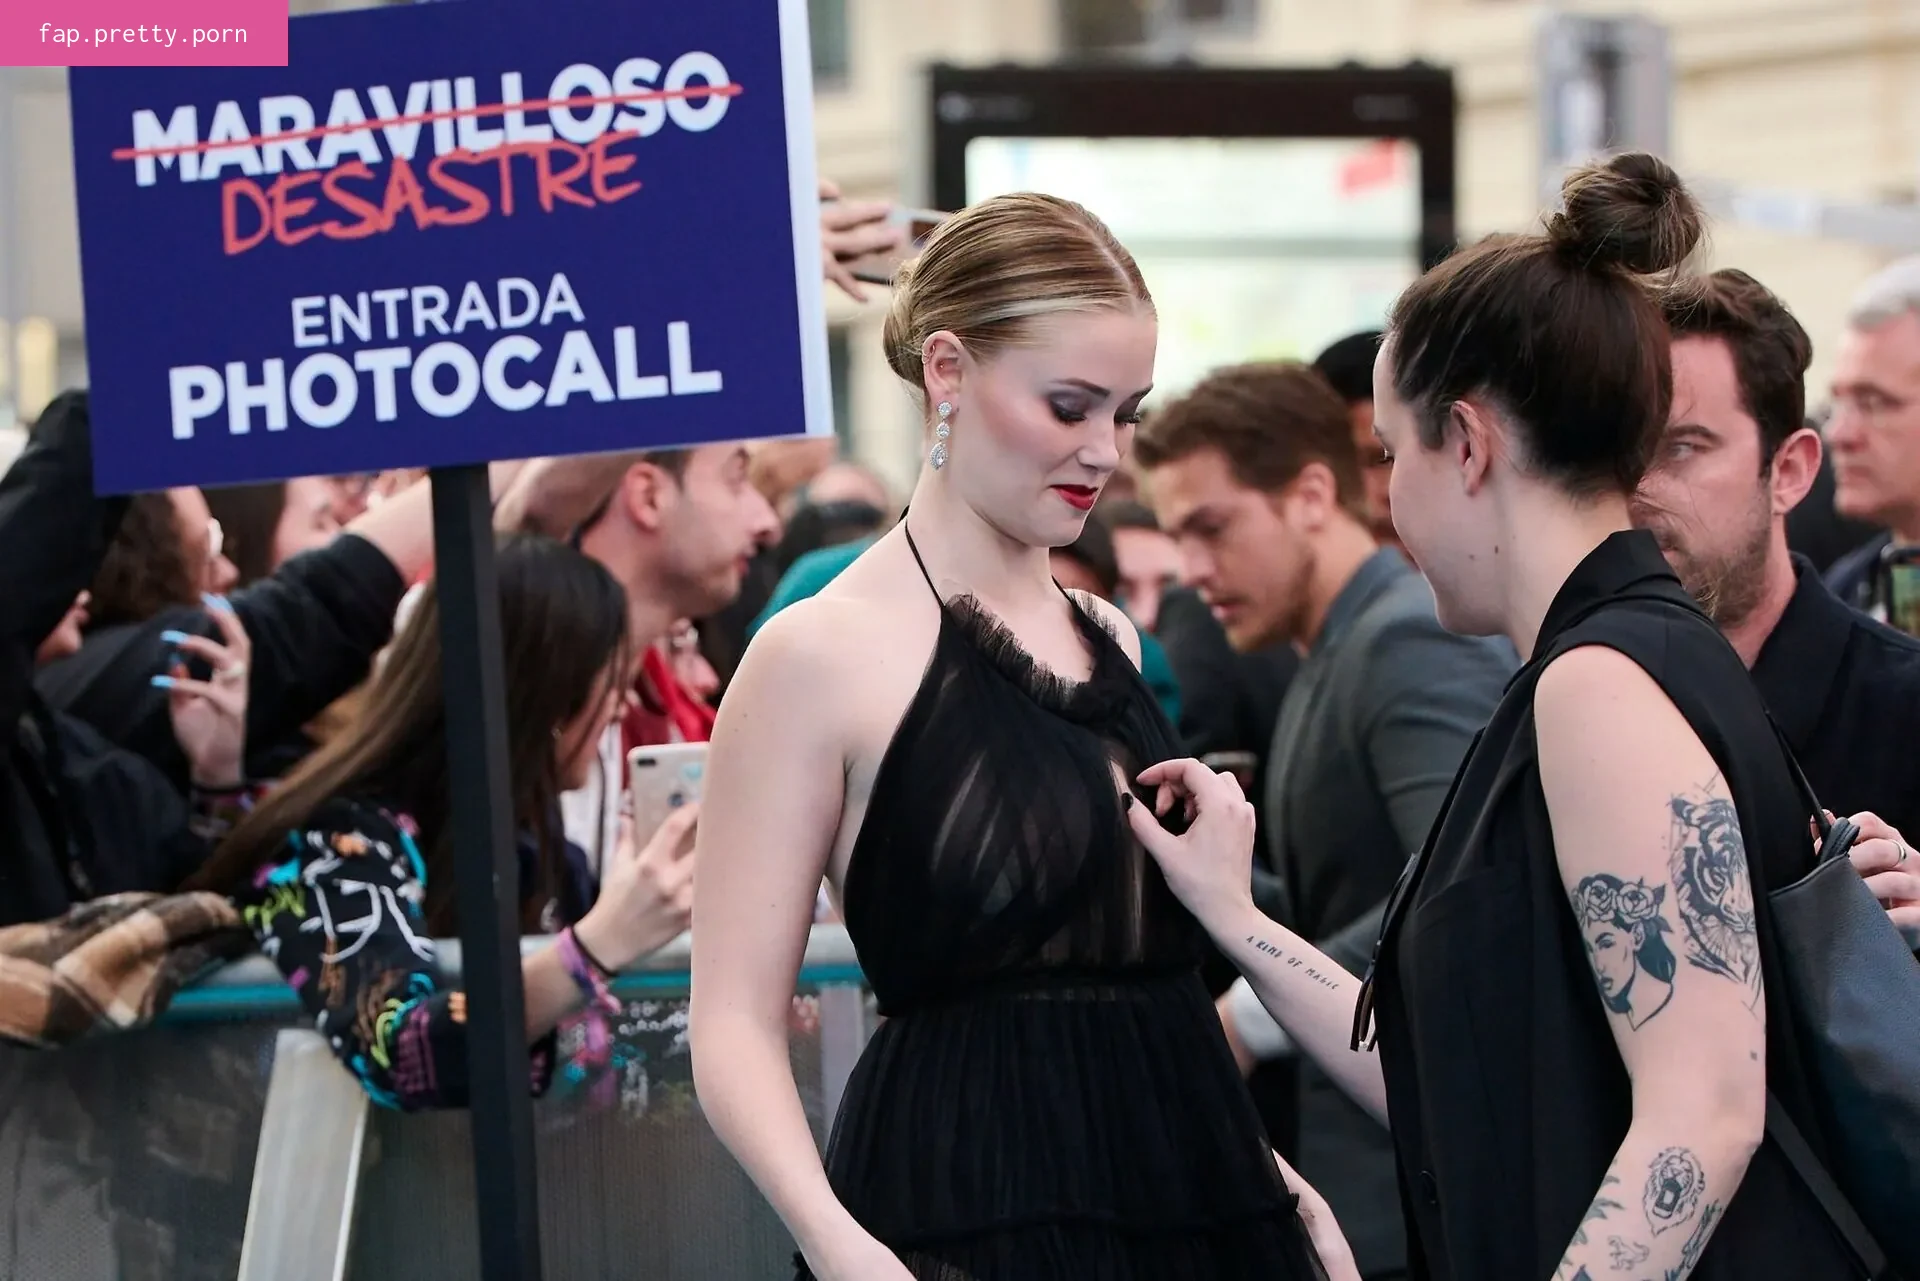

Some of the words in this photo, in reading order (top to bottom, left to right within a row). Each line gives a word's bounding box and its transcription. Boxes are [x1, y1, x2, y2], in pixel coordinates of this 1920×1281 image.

[132, 51, 731, 186] MARAVILLOSO
[222, 130, 642, 255] DESASTRE
[292, 272, 585, 348] ENTRADA
[169, 322, 723, 440] PHOTOCALL
[1246, 935, 1255, 944] A
[1287, 957, 1302, 967] OF
[1305, 968, 1340, 990] MAGIC
